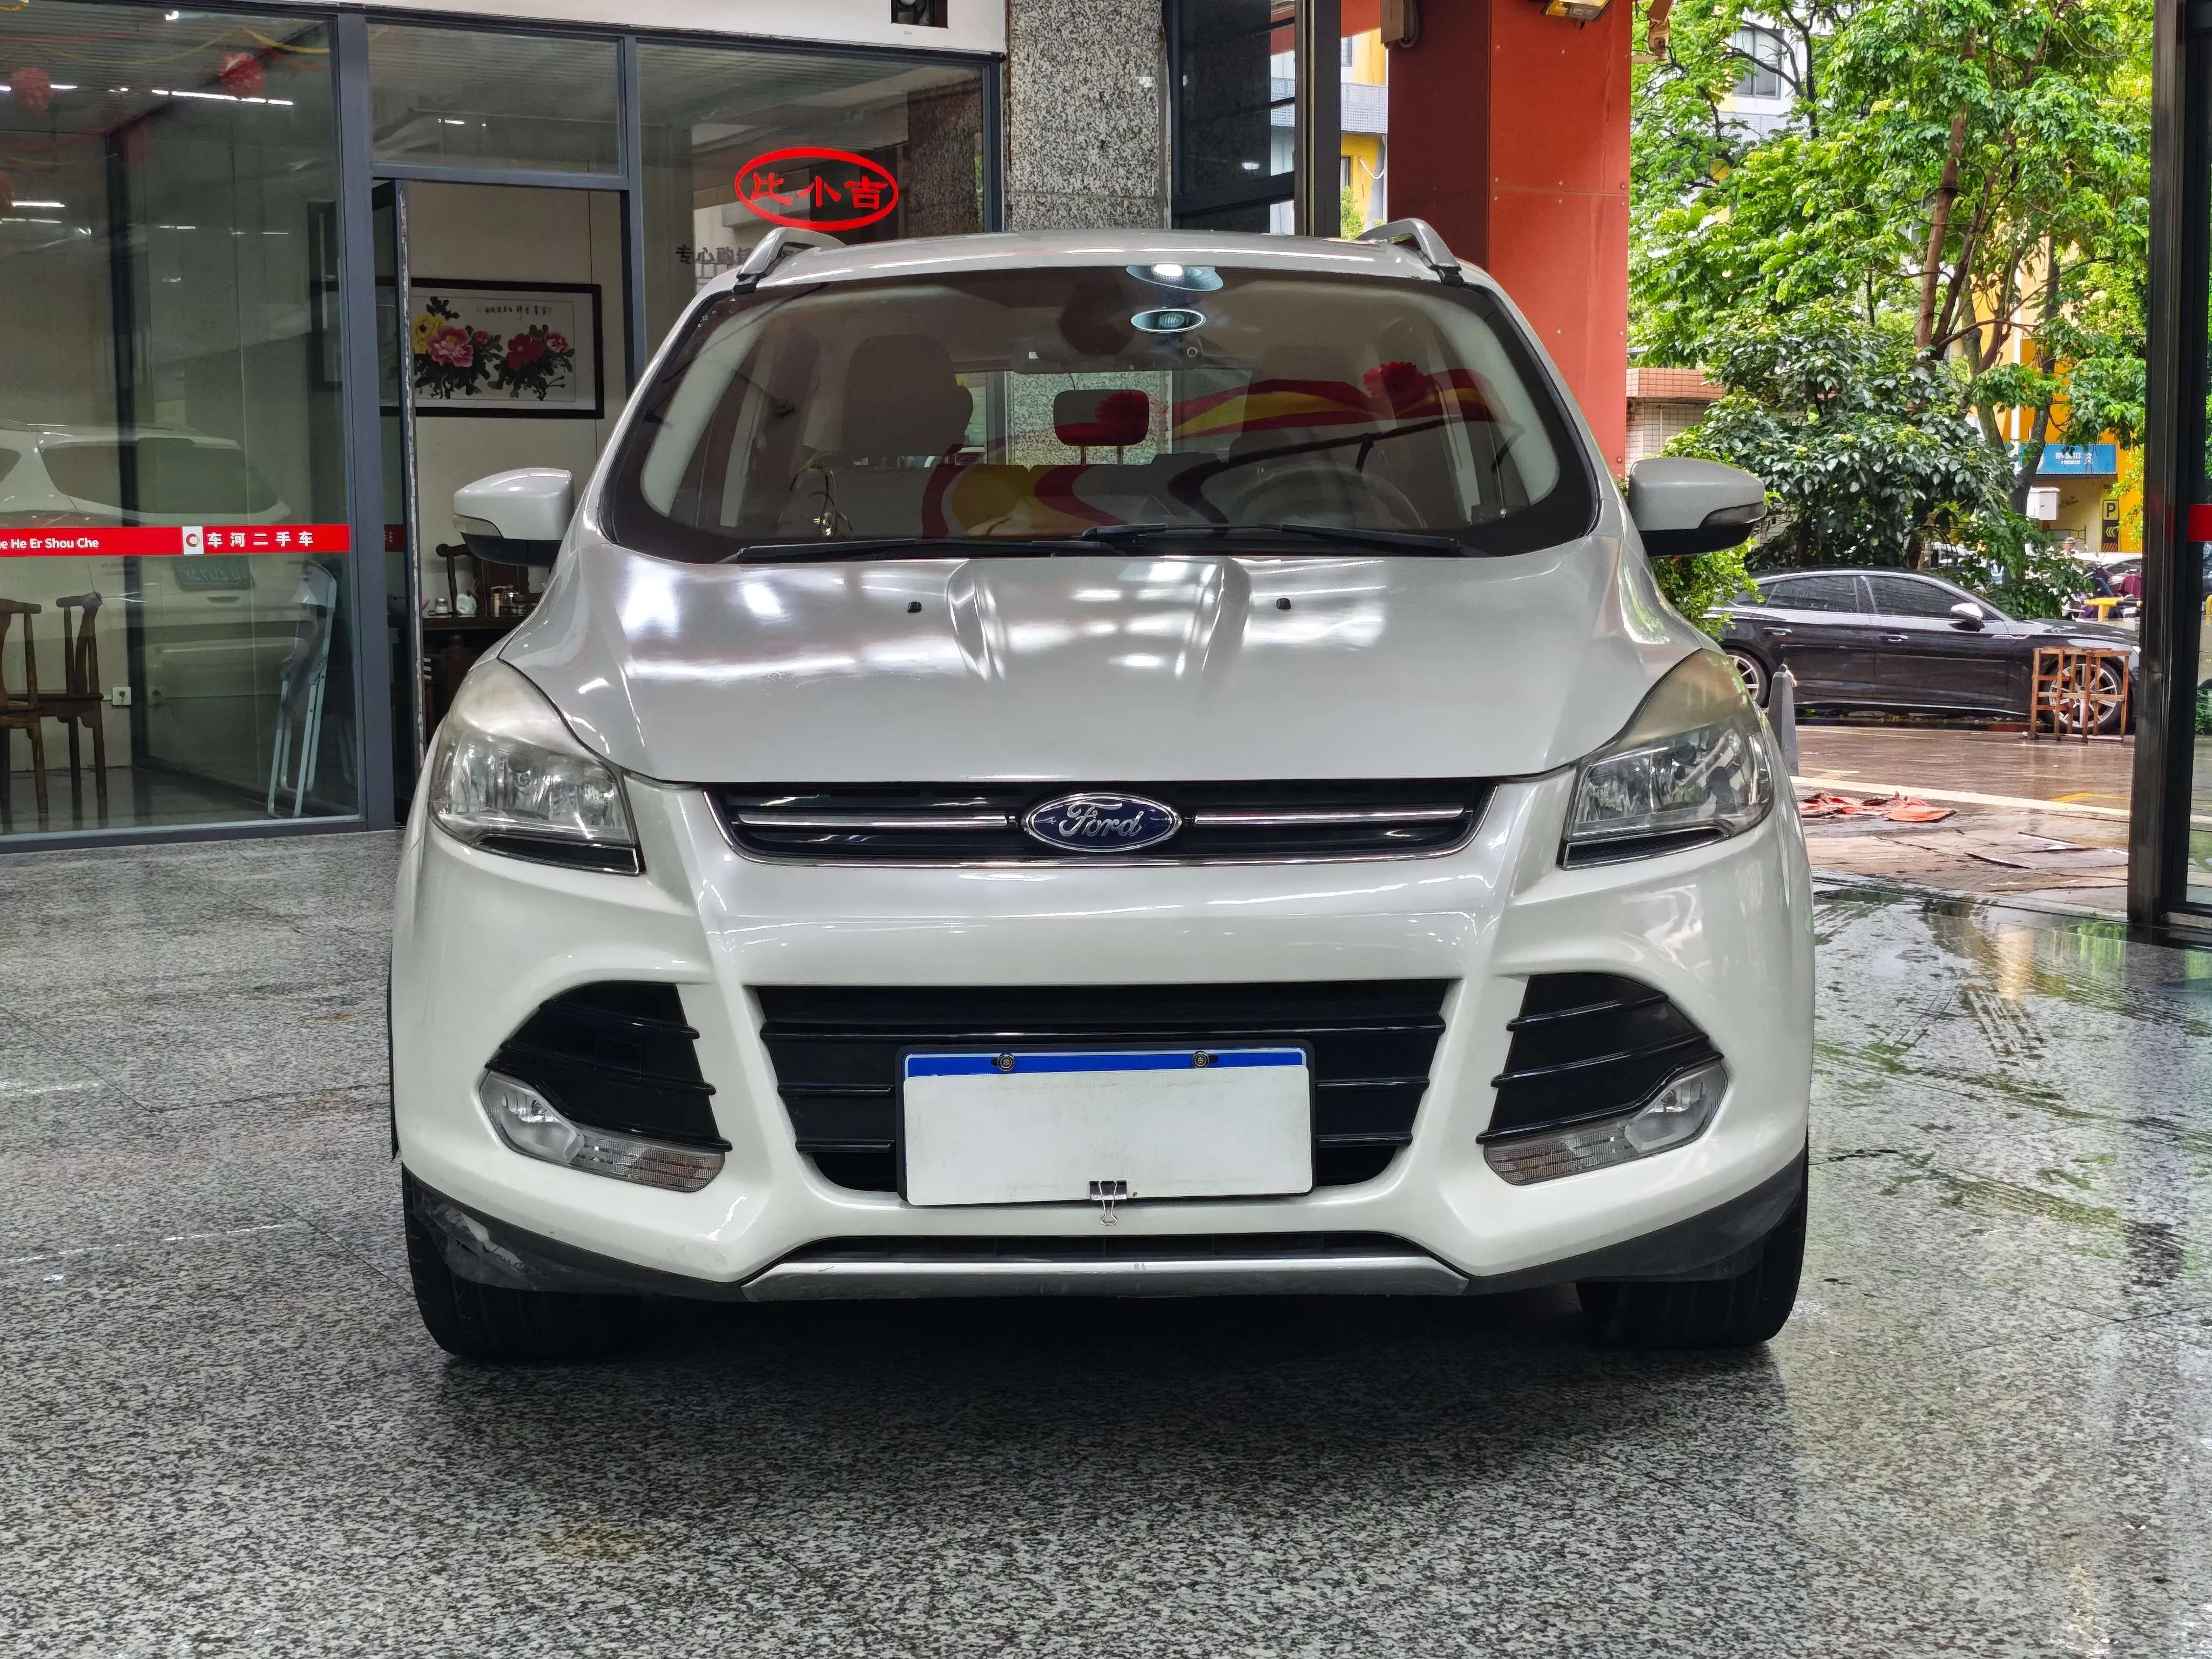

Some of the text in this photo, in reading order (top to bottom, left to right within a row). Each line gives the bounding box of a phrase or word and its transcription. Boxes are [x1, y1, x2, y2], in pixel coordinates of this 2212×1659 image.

[751, 172, 888, 210] 比小吉
[2106, 503, 2116, 518] P
[11, 538, 27, 549] He
[30, 538, 43, 549] Er
[45, 537, 75, 549] Shou
[77, 537, 99, 548] Che
[207, 531, 314, 548] 车河二手车
[1058, 802, 1144, 837] Ford
